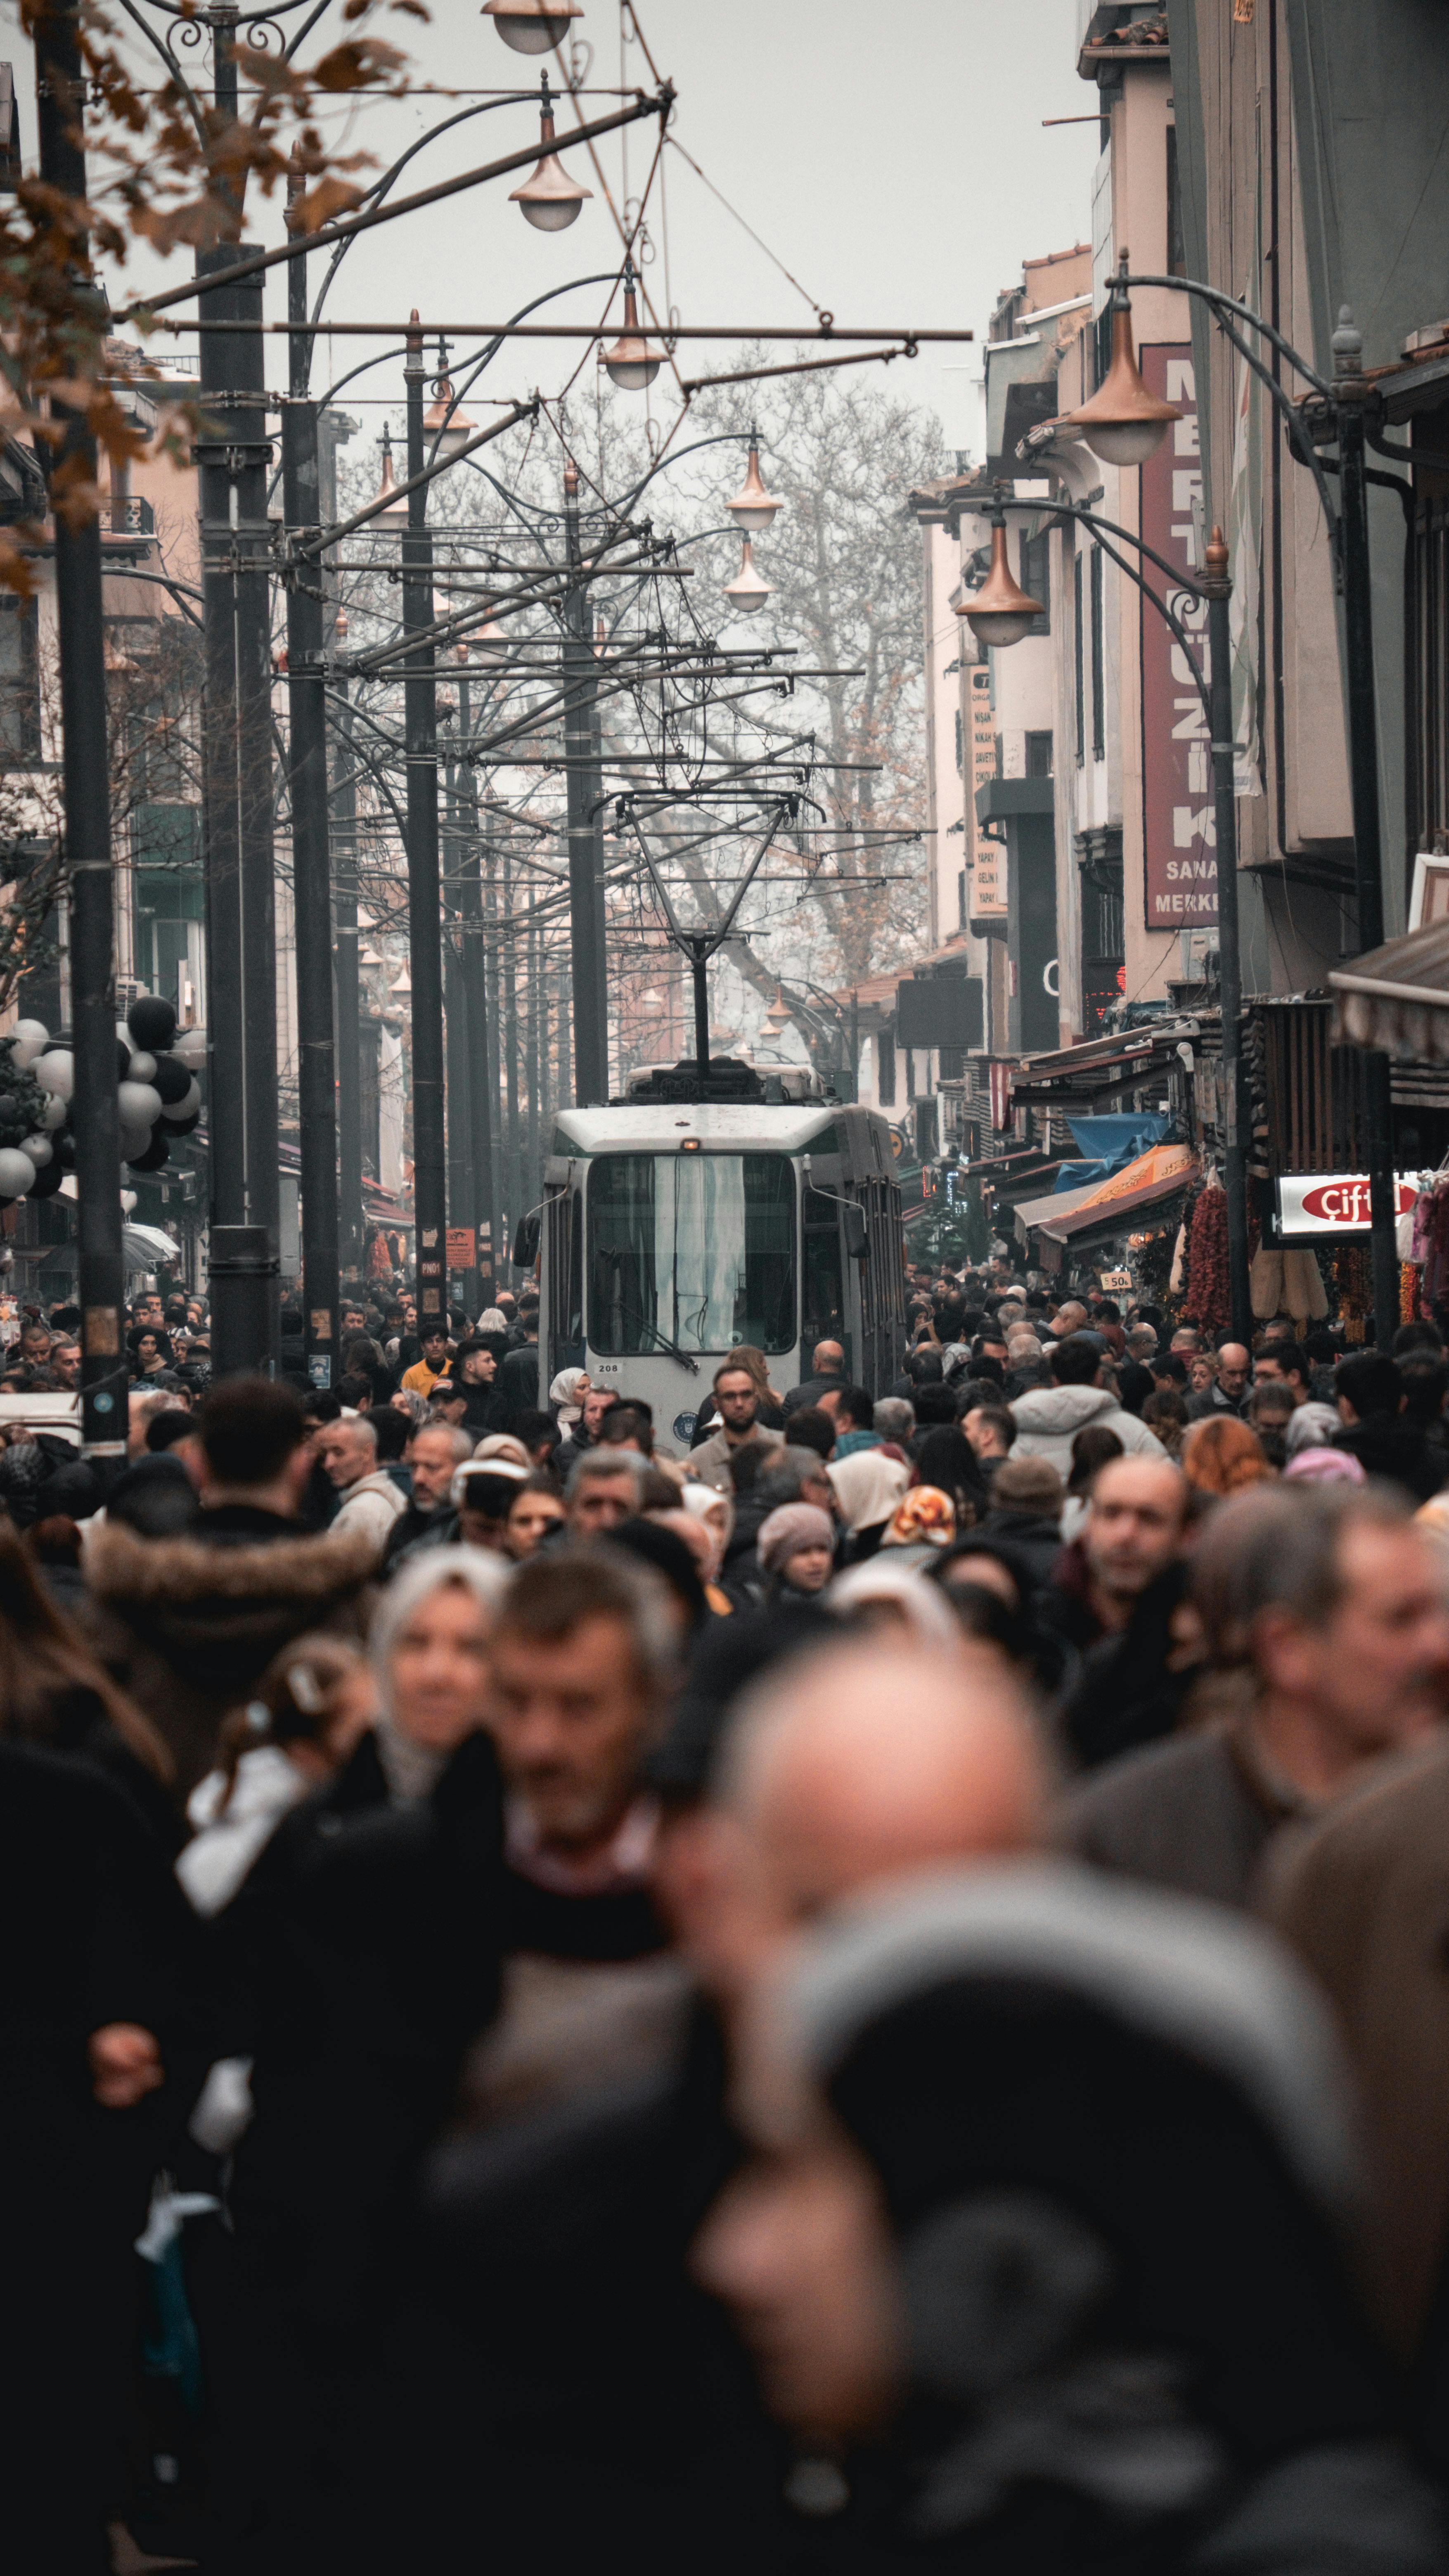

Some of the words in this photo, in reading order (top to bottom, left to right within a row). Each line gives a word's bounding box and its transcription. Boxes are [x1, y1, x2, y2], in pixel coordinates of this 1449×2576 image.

[1166, 590, 1217, 848] MÜZİK
[978, 870, 994, 883] GELİN
[422, 1263, 440, 1274] PN01
